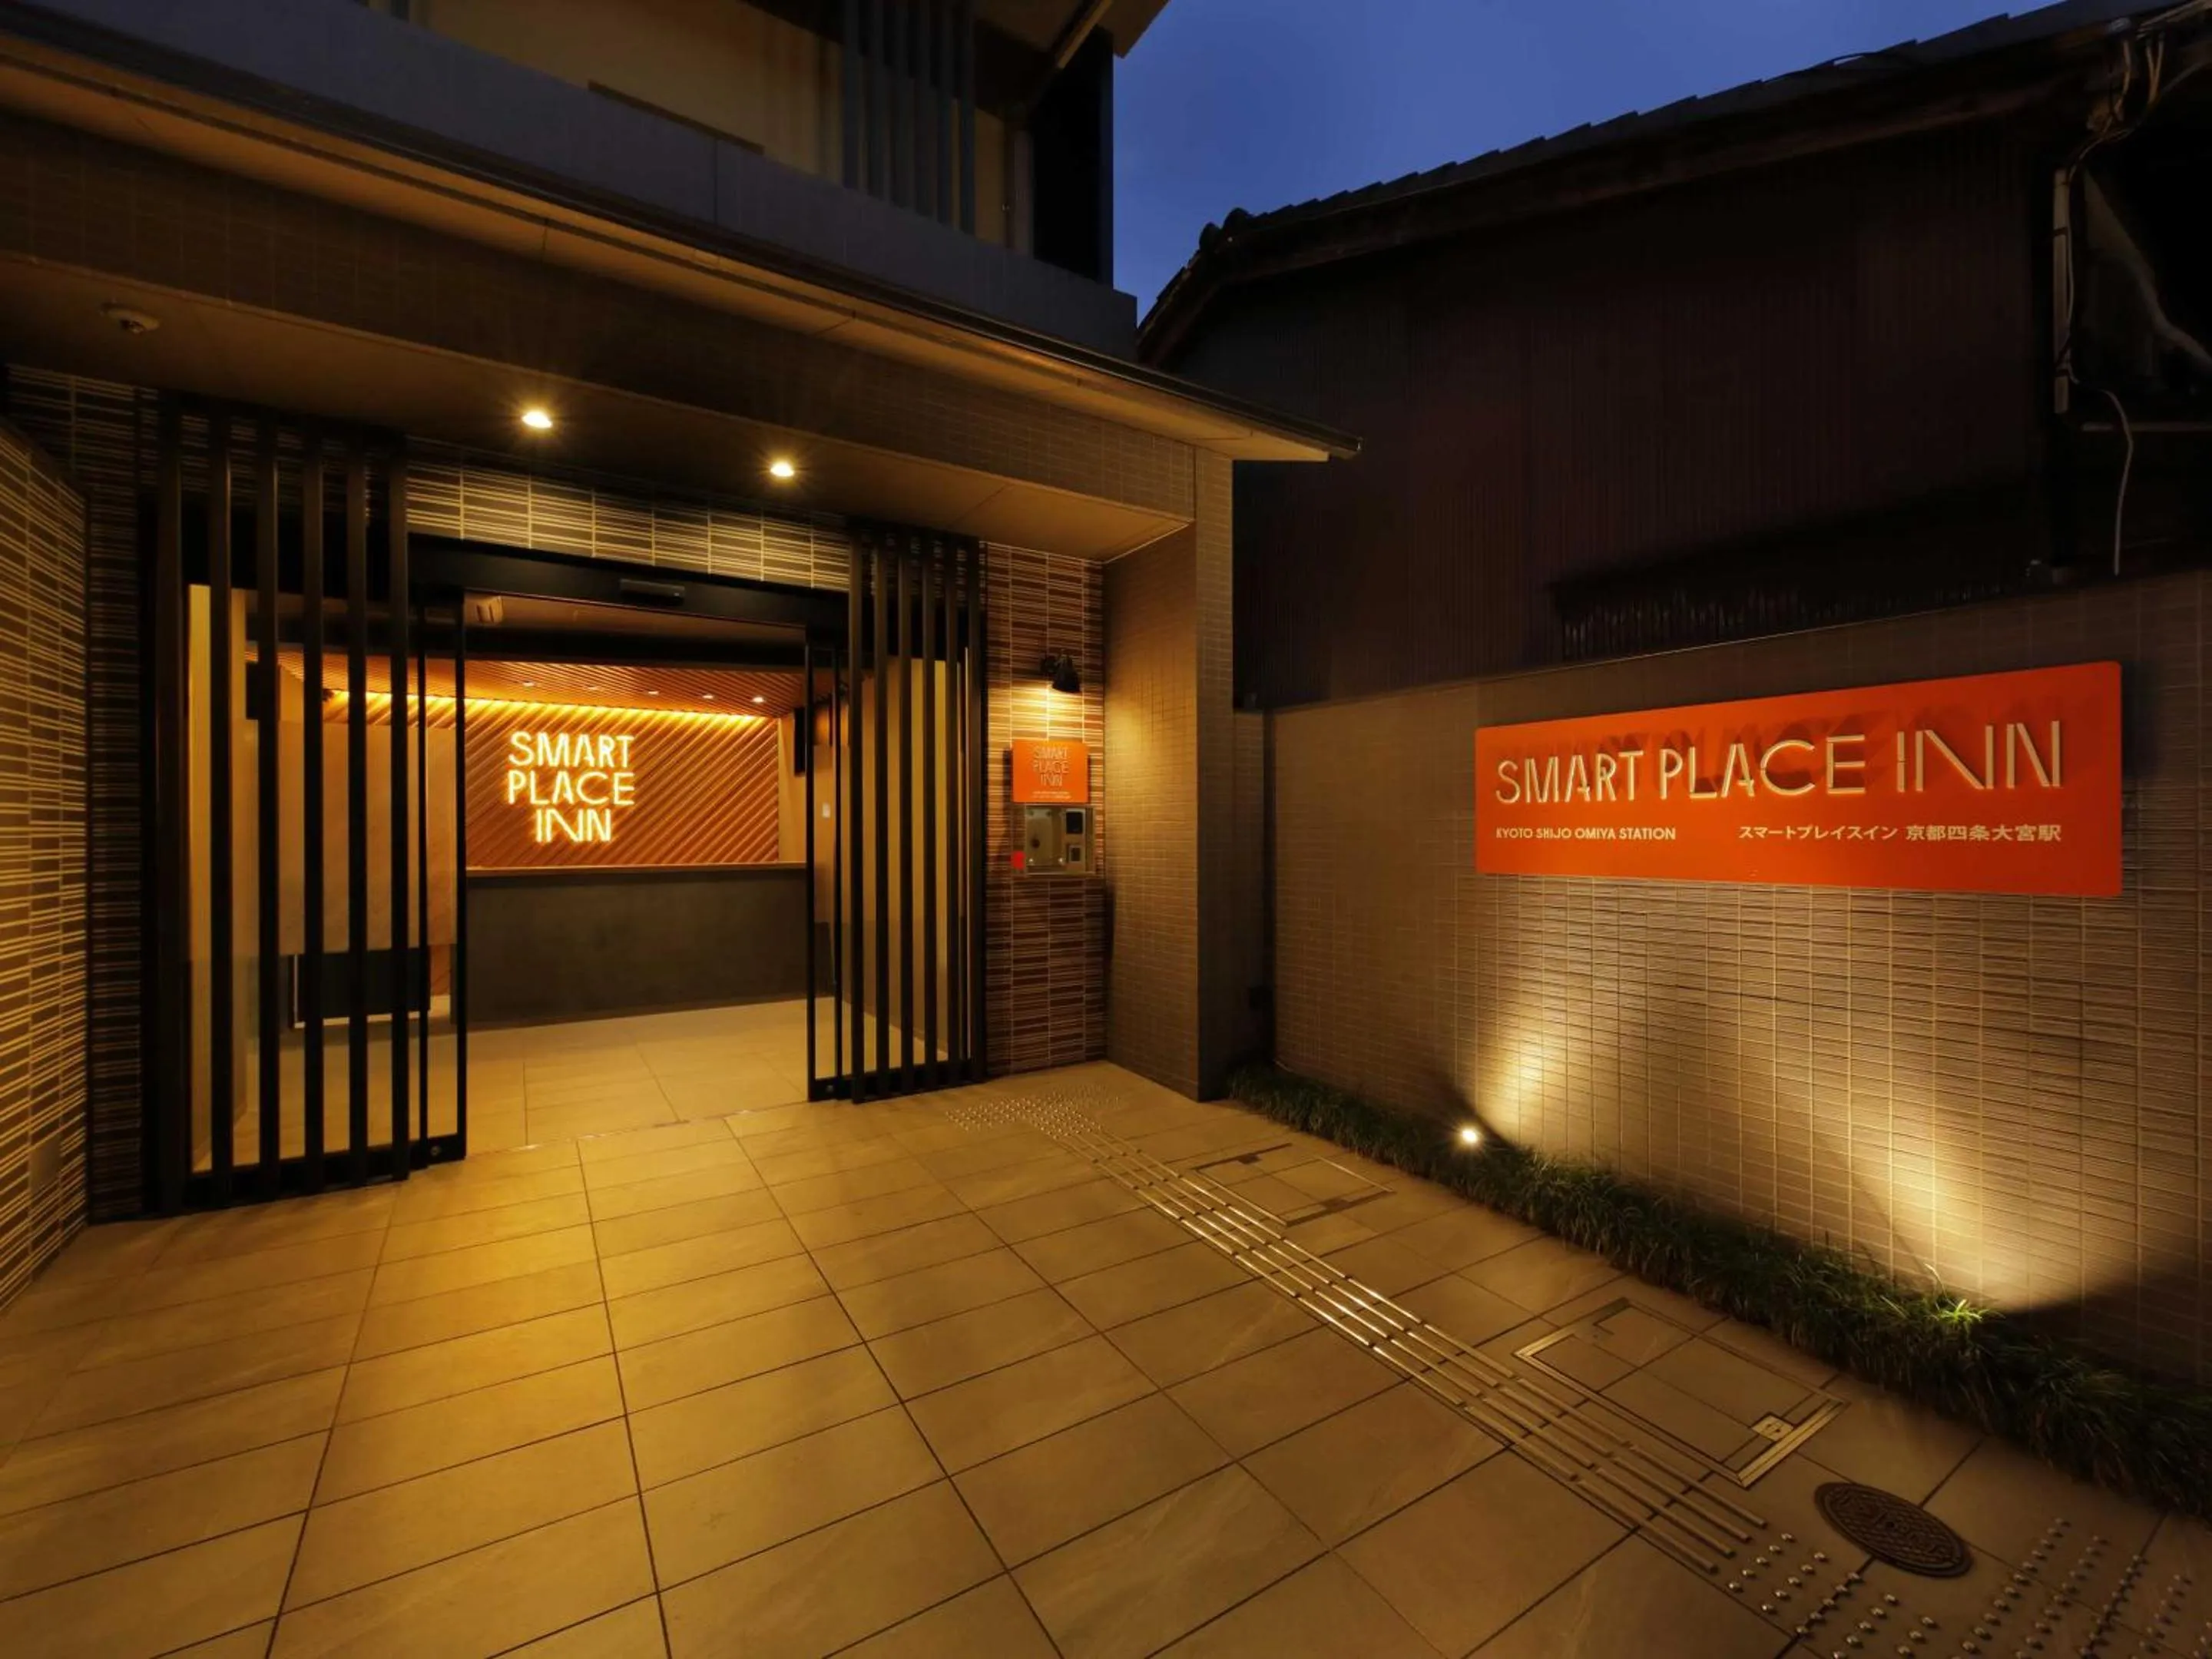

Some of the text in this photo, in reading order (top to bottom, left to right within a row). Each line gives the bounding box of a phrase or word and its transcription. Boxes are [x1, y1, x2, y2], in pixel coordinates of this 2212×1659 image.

[508, 731, 634, 768] SMART
[1033, 746, 1068, 760] SMART
[1495, 720, 2061, 805] SMART PLACE INN
[1033, 760, 1069, 773] PLACE
[507, 770, 634, 806] PLACE
[535, 808, 611, 843] INN
[1496, 827, 1676, 840] KYOTO SHIJO OMIYA STATION
[1739, 824, 2062, 842] スマートプレイスイン 京都四条大宮駅
